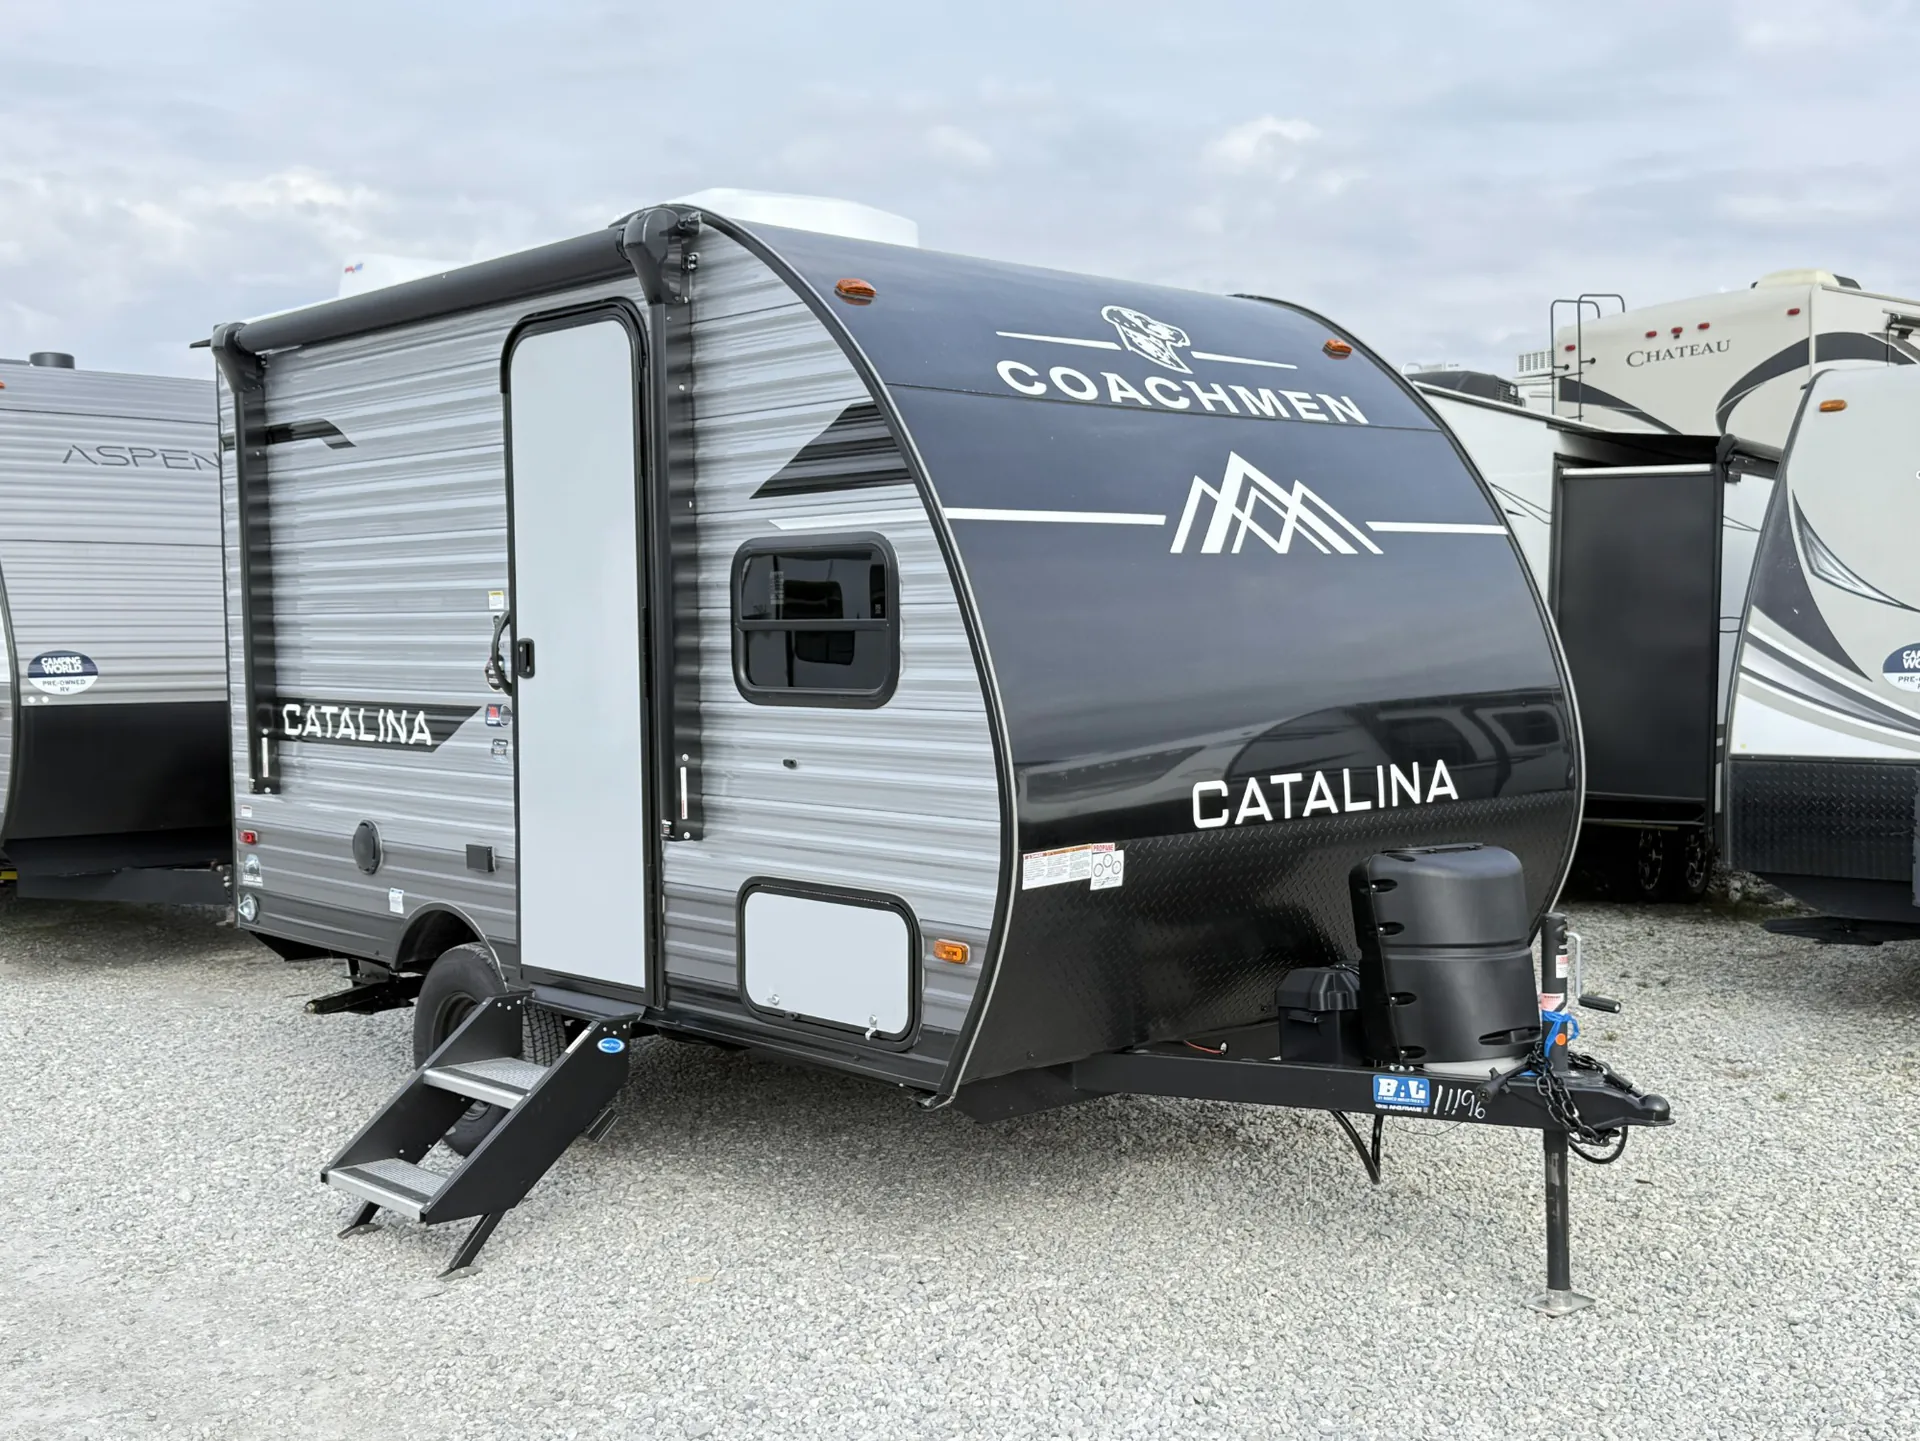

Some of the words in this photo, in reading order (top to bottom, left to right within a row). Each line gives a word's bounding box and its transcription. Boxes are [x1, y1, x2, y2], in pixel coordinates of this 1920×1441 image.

[1626, 339, 1731, 368] CHATEAU
[996, 360, 1369, 424] COACHMEN
[62, 444, 221, 471] ASPEN
[41, 656, 81, 666] CAMPING
[42, 664, 83, 675] WORLD
[282, 703, 432, 746] CATALINA
[1192, 759, 1459, 829] CATALINA
